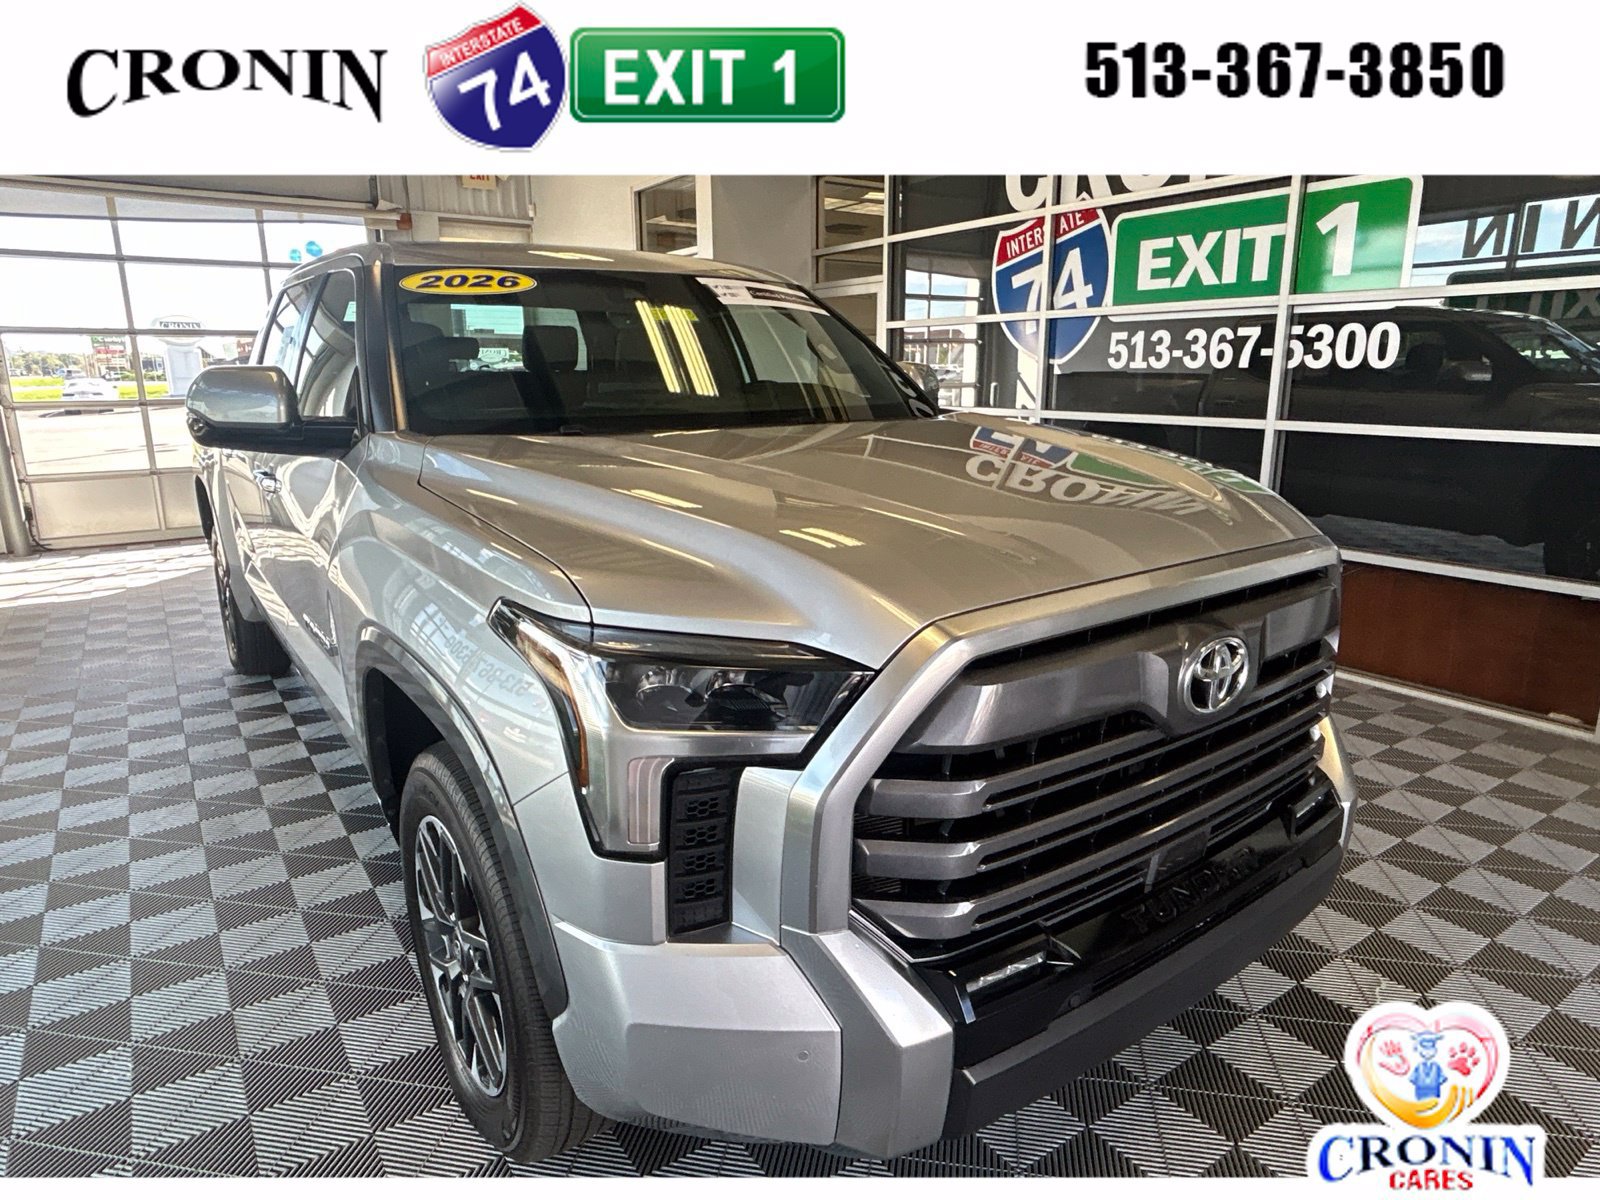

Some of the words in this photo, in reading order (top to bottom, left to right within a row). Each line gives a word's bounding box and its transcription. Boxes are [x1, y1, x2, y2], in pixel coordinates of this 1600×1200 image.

[1136, 222, 1287, 292] EXIT
[1316, 201, 1360, 277] 1
[415, 274, 522, 289] 2026
[1011, 247, 1094, 335] 74
[1106, 320, 1400, 370] 513-367-5300
